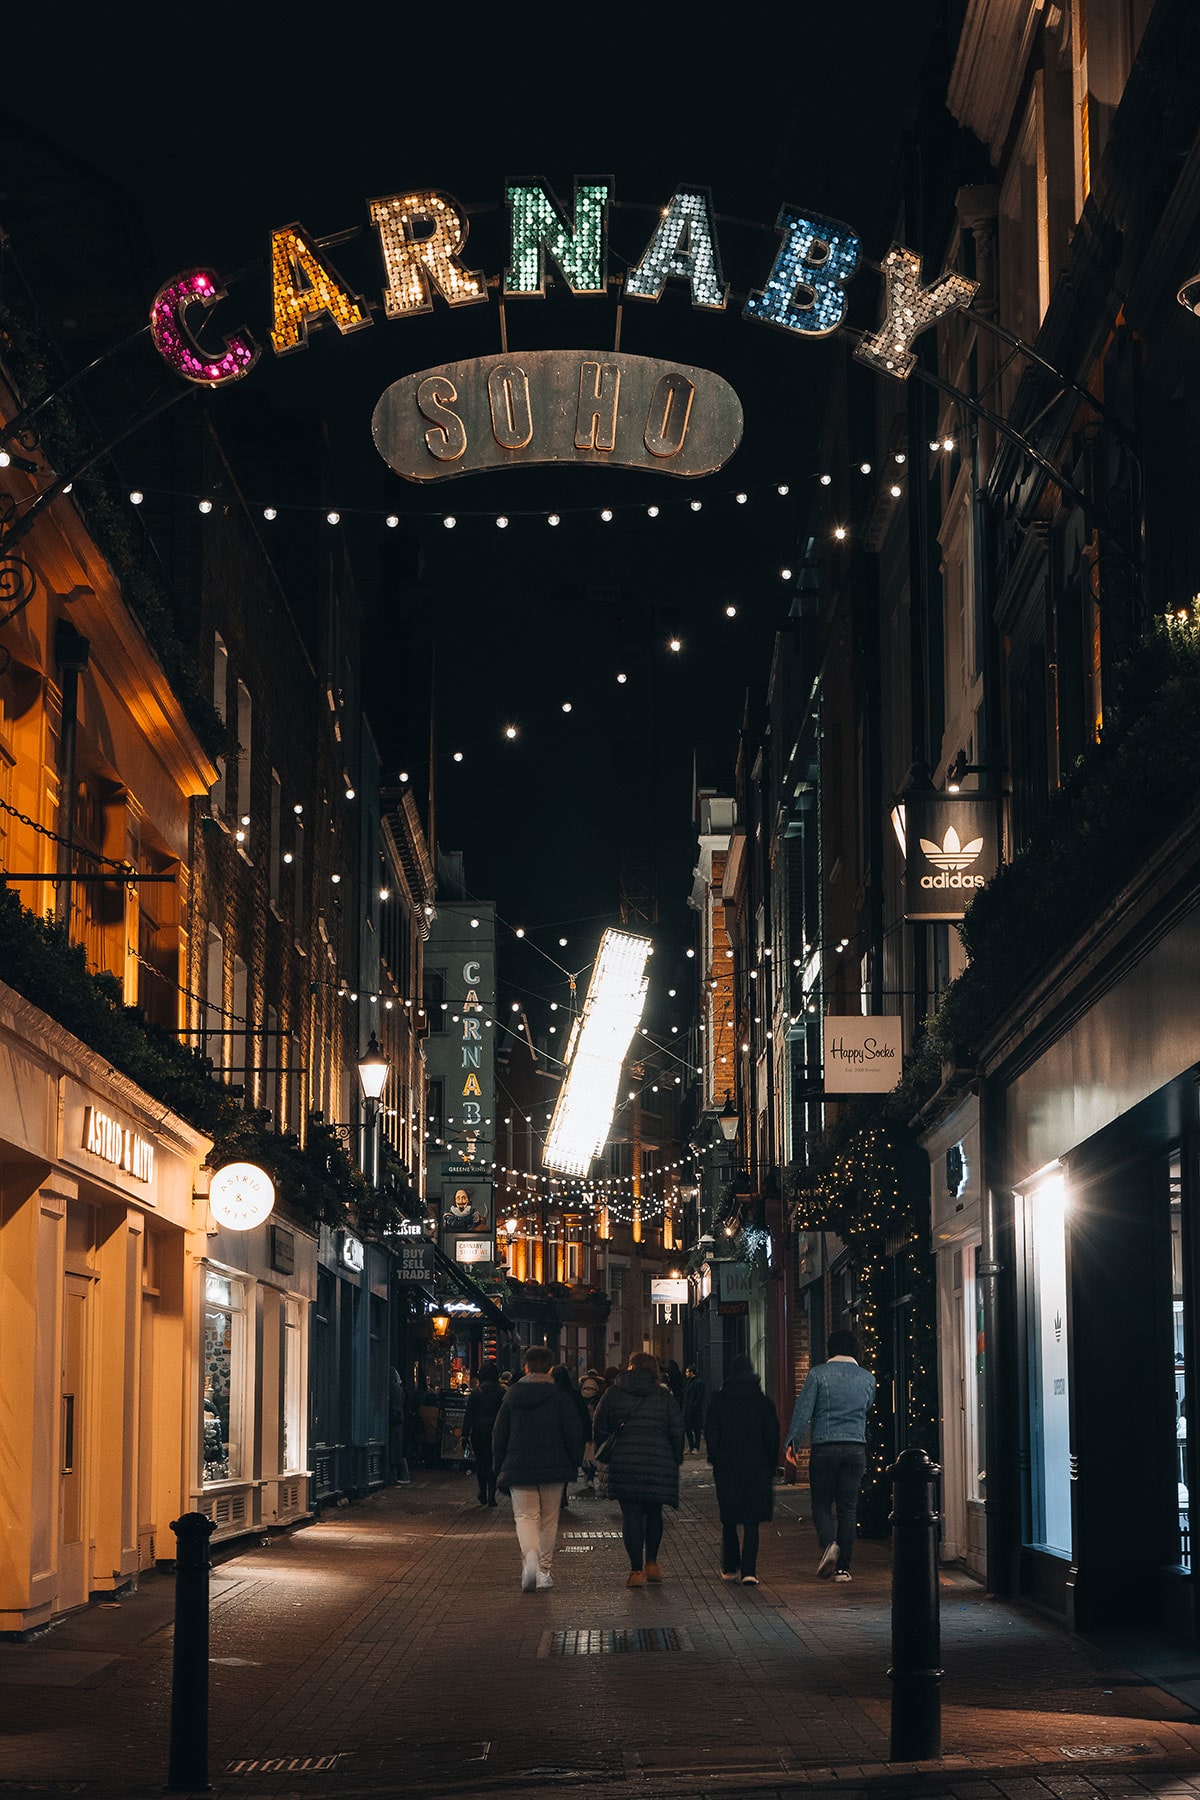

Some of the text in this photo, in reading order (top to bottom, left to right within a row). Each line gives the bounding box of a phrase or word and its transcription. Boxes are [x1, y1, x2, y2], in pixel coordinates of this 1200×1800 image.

[149, 174, 979, 389] CARNABY
[416, 360, 696, 462] SOHO
[920, 872, 985, 889] adidas
[87, 1105, 154, 1185] ASTRID & MIYU
[220, 1175, 261, 1192] ASTRID
[235, 1192, 243, 1202] &
[402, 1248, 425, 1259] BUY
[402, 1259, 425, 1269] SELL
[396, 1269, 431, 1280] TRADE
